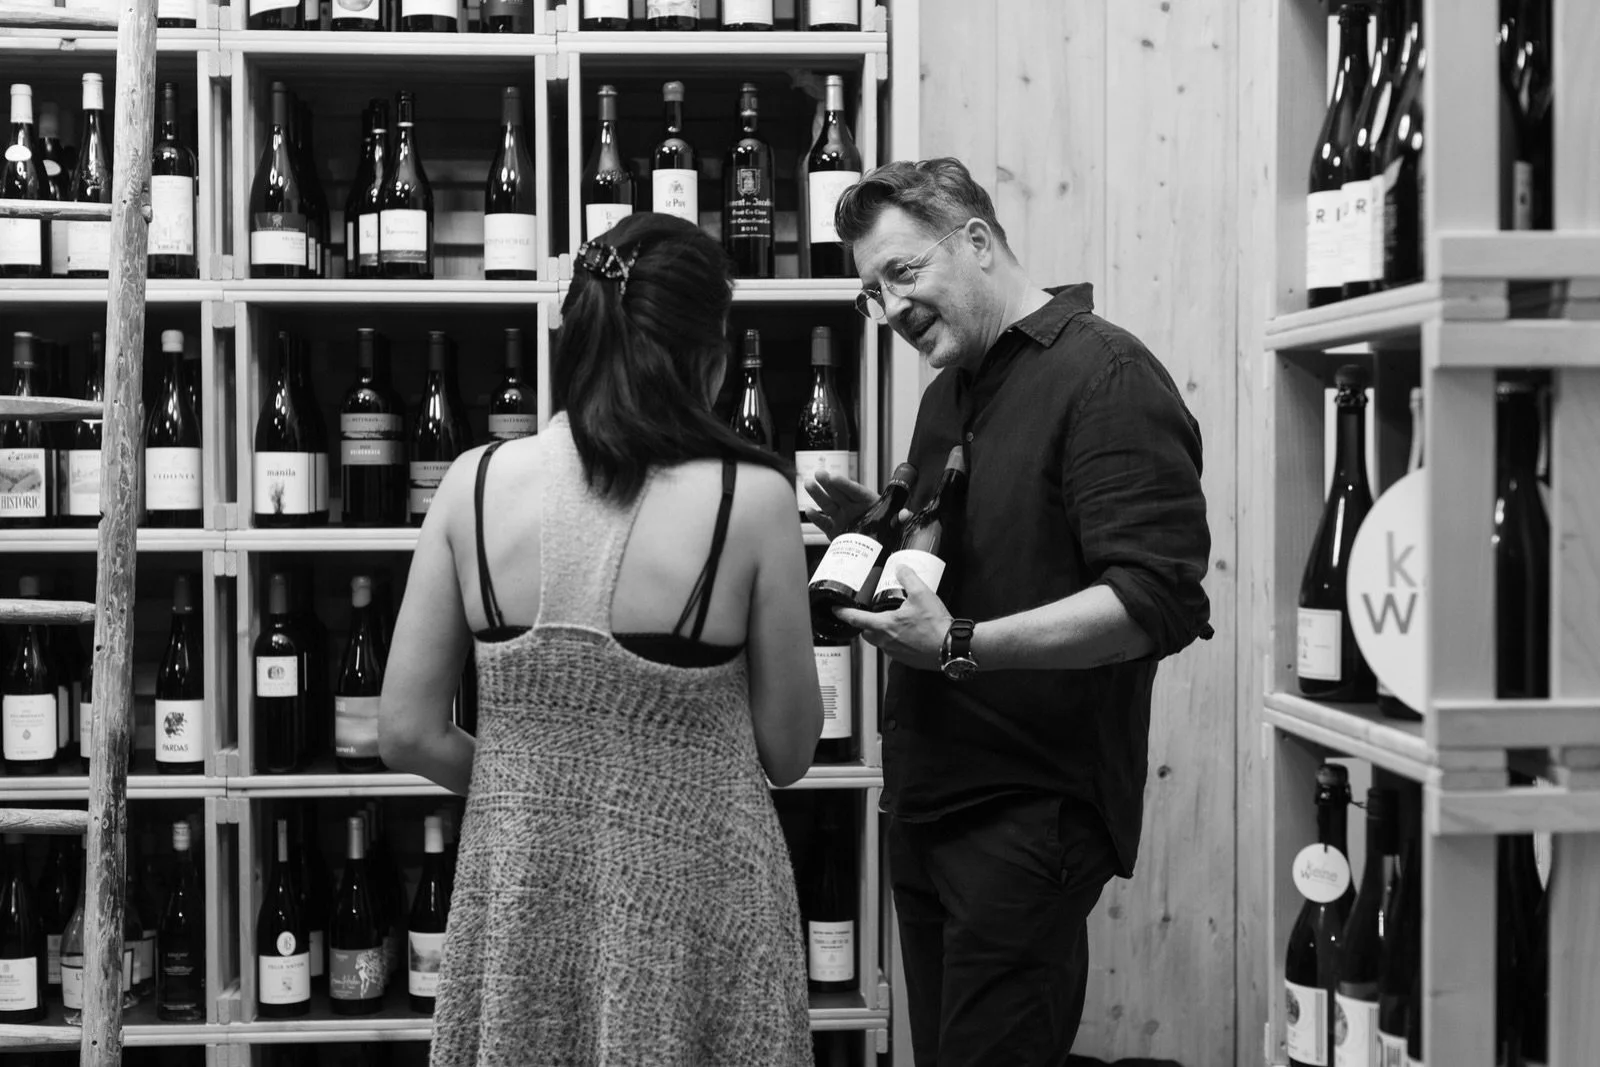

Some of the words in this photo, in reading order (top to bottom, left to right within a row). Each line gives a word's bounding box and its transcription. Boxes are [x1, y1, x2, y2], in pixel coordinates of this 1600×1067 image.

[267, 468, 296, 477] manila
[1, 495, 40, 509] HISTORIC
[162, 744, 189, 752] PARDAS
